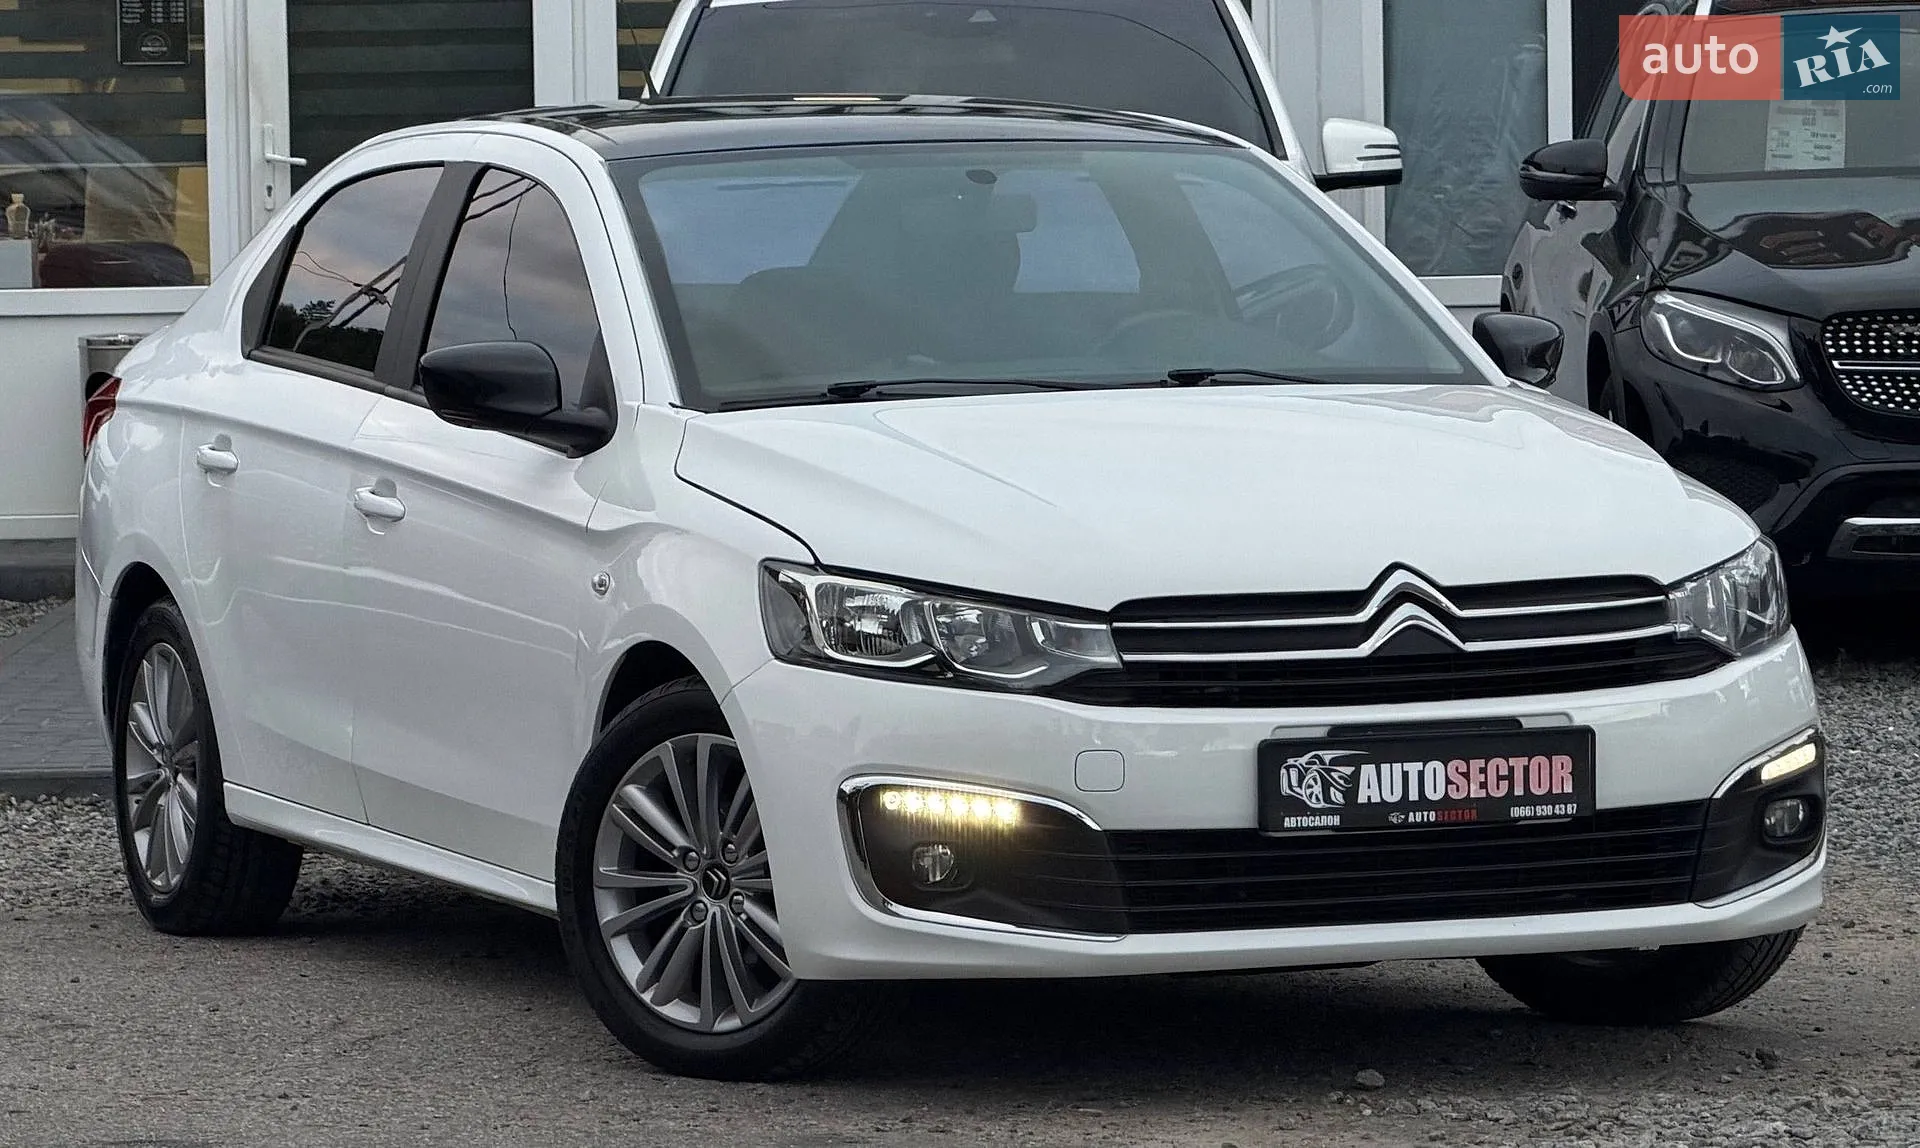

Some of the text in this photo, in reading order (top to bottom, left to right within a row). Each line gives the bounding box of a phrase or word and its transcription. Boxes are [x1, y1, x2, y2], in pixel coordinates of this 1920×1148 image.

[1357, 755, 1572, 803] AUTOSECTOR
[1408, 809, 1478, 823] AUTOSECTOR
[1510, 803, 1577, 818] (066) 930 43 87
[1283, 815, 1341, 828] АВТОСАЛОН
